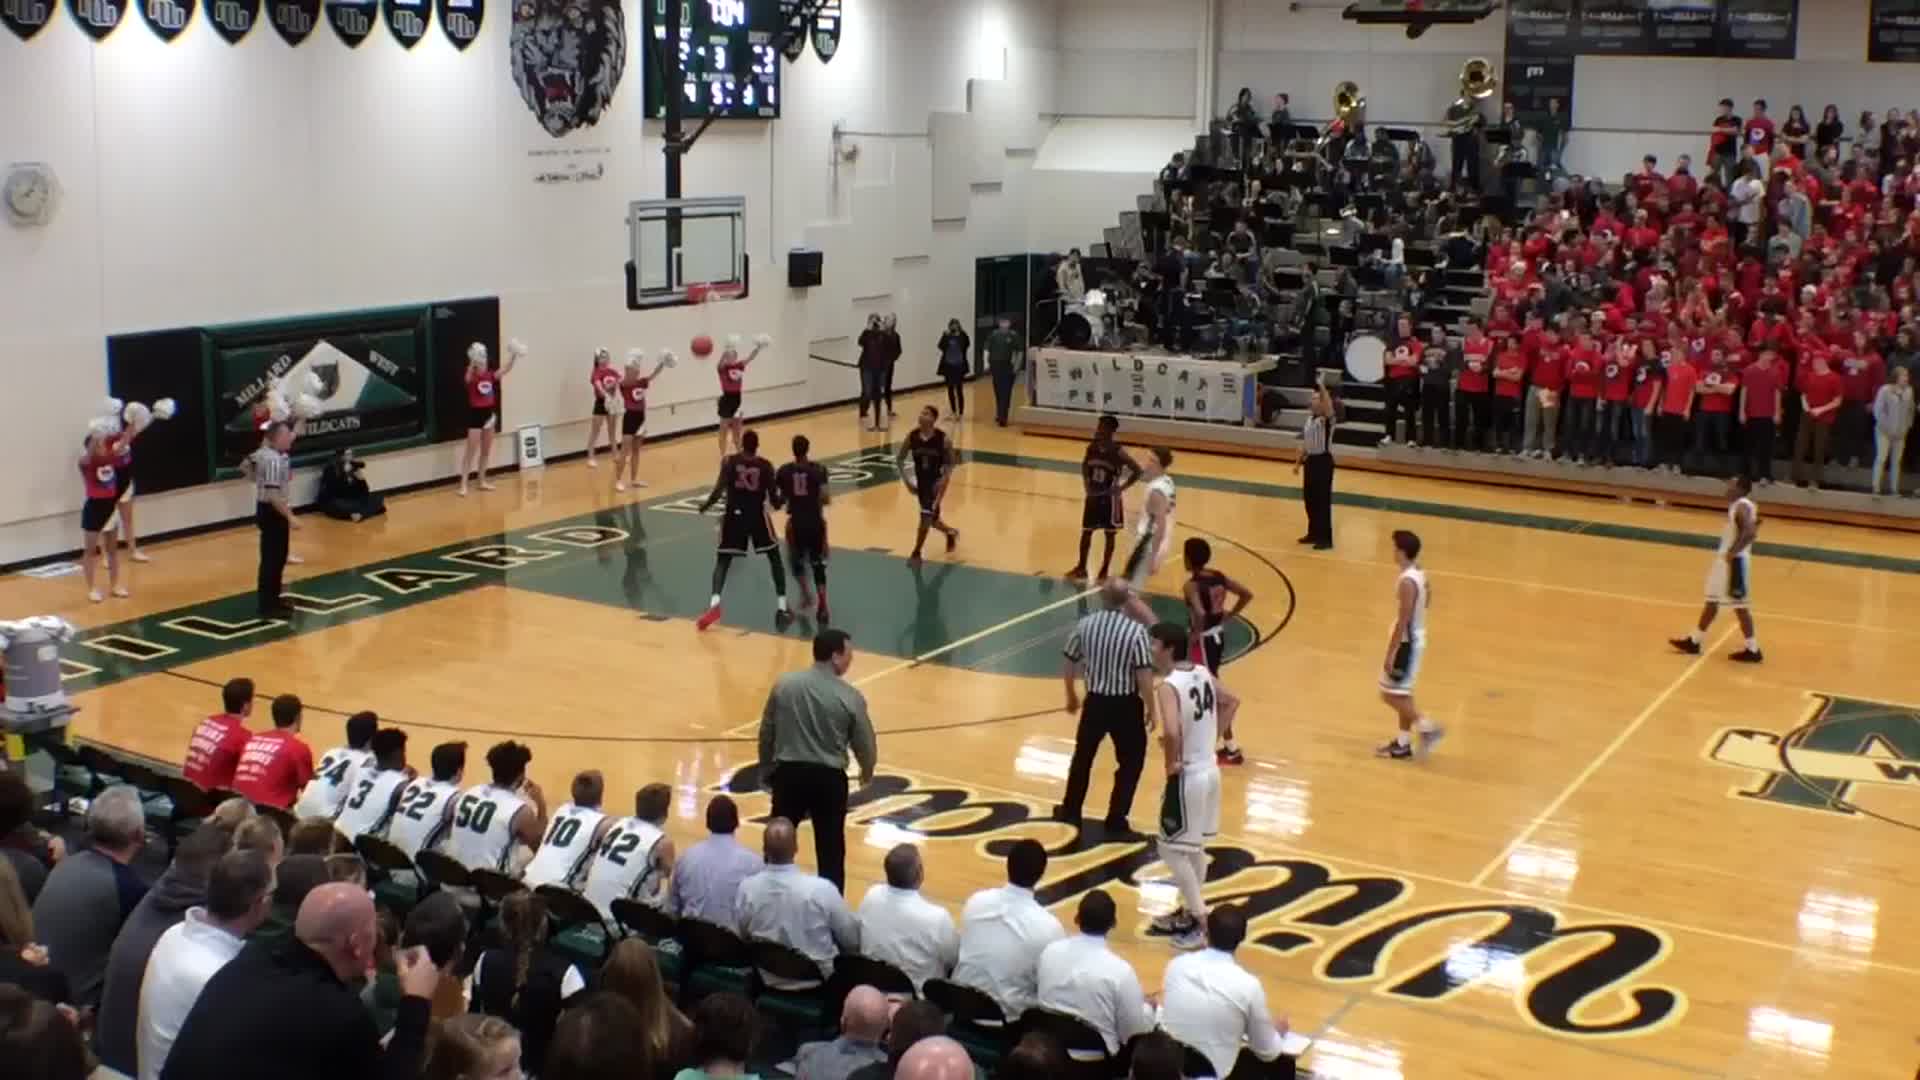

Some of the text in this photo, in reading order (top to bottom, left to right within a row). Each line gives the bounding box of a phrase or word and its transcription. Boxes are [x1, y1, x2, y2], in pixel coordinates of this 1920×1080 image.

[1069, 359, 1208, 391] WILDCAT
[1068, 389, 1112, 404] PEP
[1132, 395, 1206, 412] BAND
[303, 416, 361, 436] ILDCATS
[58, 525, 630, 680] ILLARD
[1189, 680, 1215, 721] 34
[315, 756, 351, 786] 24
[348, 779, 375, 810] 3
[398, 785, 436, 822] 22
[456, 794, 498, 835] 50
[543, 815, 583, 848] 10
